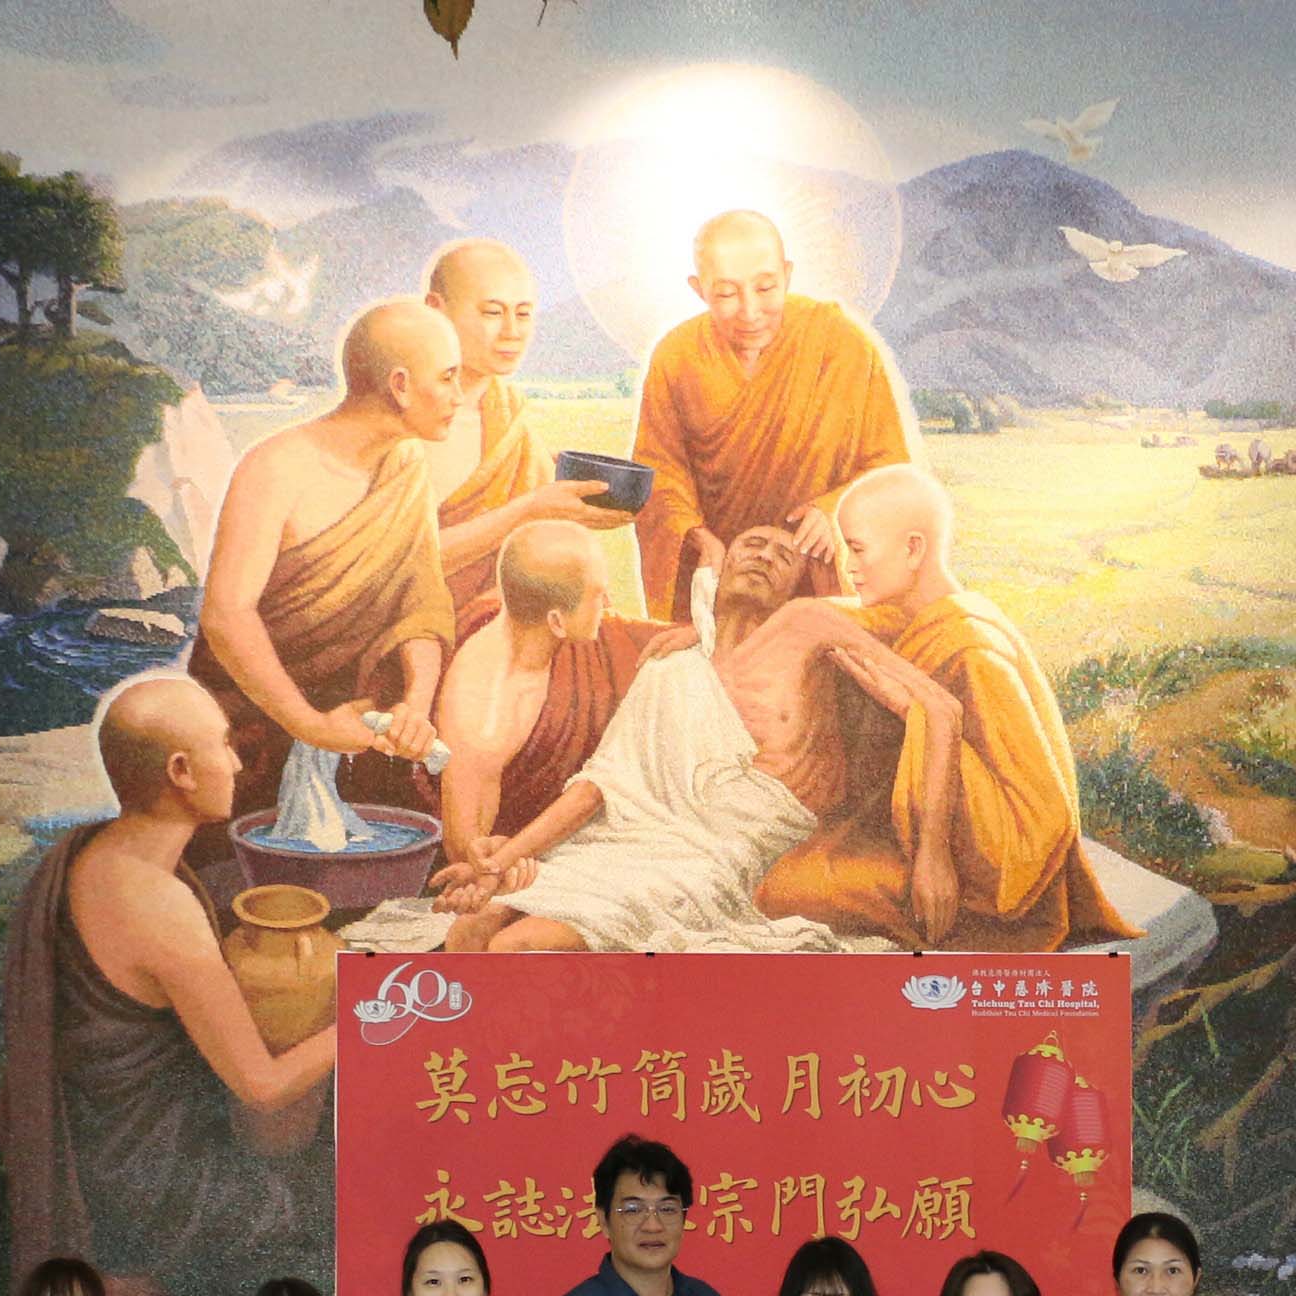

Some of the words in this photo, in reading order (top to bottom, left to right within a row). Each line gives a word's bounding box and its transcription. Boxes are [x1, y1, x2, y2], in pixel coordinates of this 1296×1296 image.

[971, 979, 1099, 997] 台中慈濟醫院
[971, 1000, 1016, 1009] Taichung
[1038, 1000, 1054, 1009] Chi
[415, 1049, 977, 1124] 莫忘竹筒歲月初心
[415, 1169, 977, 1244] 永誌法宗門弘願
